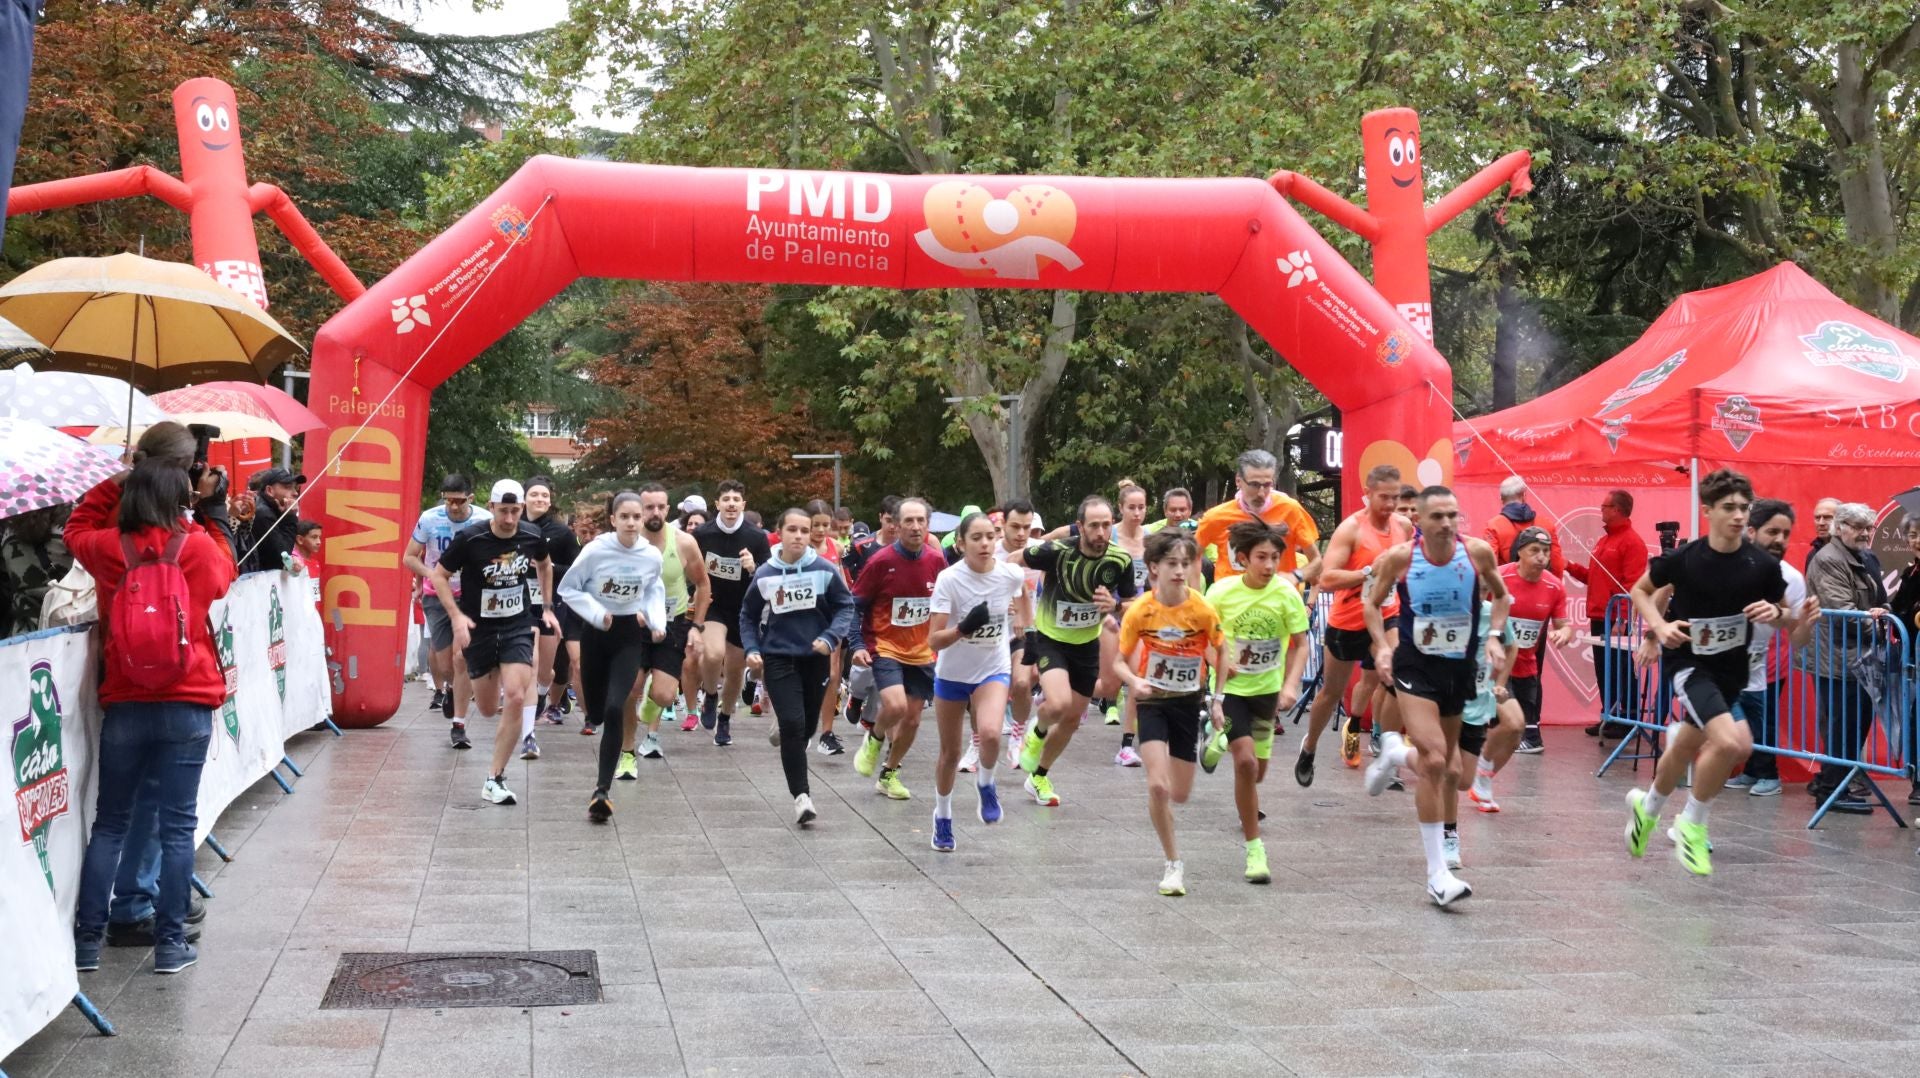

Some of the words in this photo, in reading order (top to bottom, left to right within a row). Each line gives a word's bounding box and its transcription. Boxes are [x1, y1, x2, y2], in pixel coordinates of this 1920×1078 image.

[745, 170, 892, 223] PMD
[746, 214, 890, 248] Ayuntamiento
[746, 239, 775, 260] de
[785, 241, 889, 271] Palencia
[428, 267, 462, 296] Patronato
[460, 239, 495, 269] Municipal
[448, 284, 459, 292] de
[456, 258, 489, 285] Deportes
[1318, 281, 1348, 310] Patronato
[1347, 307, 1379, 336] Municipal
[1323, 299, 1332, 308] de
[1331, 305, 1360, 332] Deportes
[329, 394, 406, 419] Palencia
[1828, 442, 1848, 457] La
[325, 425, 402, 627] PMD
[483, 554, 529, 577] FLAMES
[720, 566, 735, 574] 53
[612, 585, 638, 596] 221
[785, 588, 813, 602] 162
[496, 595, 520, 609] 100
[908, 607, 930, 618] 113
[1072, 611, 1097, 621] 187
[975, 624, 1002, 638] 222
[1446, 629, 1457, 642] 6
[1515, 629, 1538, 641] 159
[1250, 649, 1279, 665] 267
[1168, 668, 1197, 682] 150
